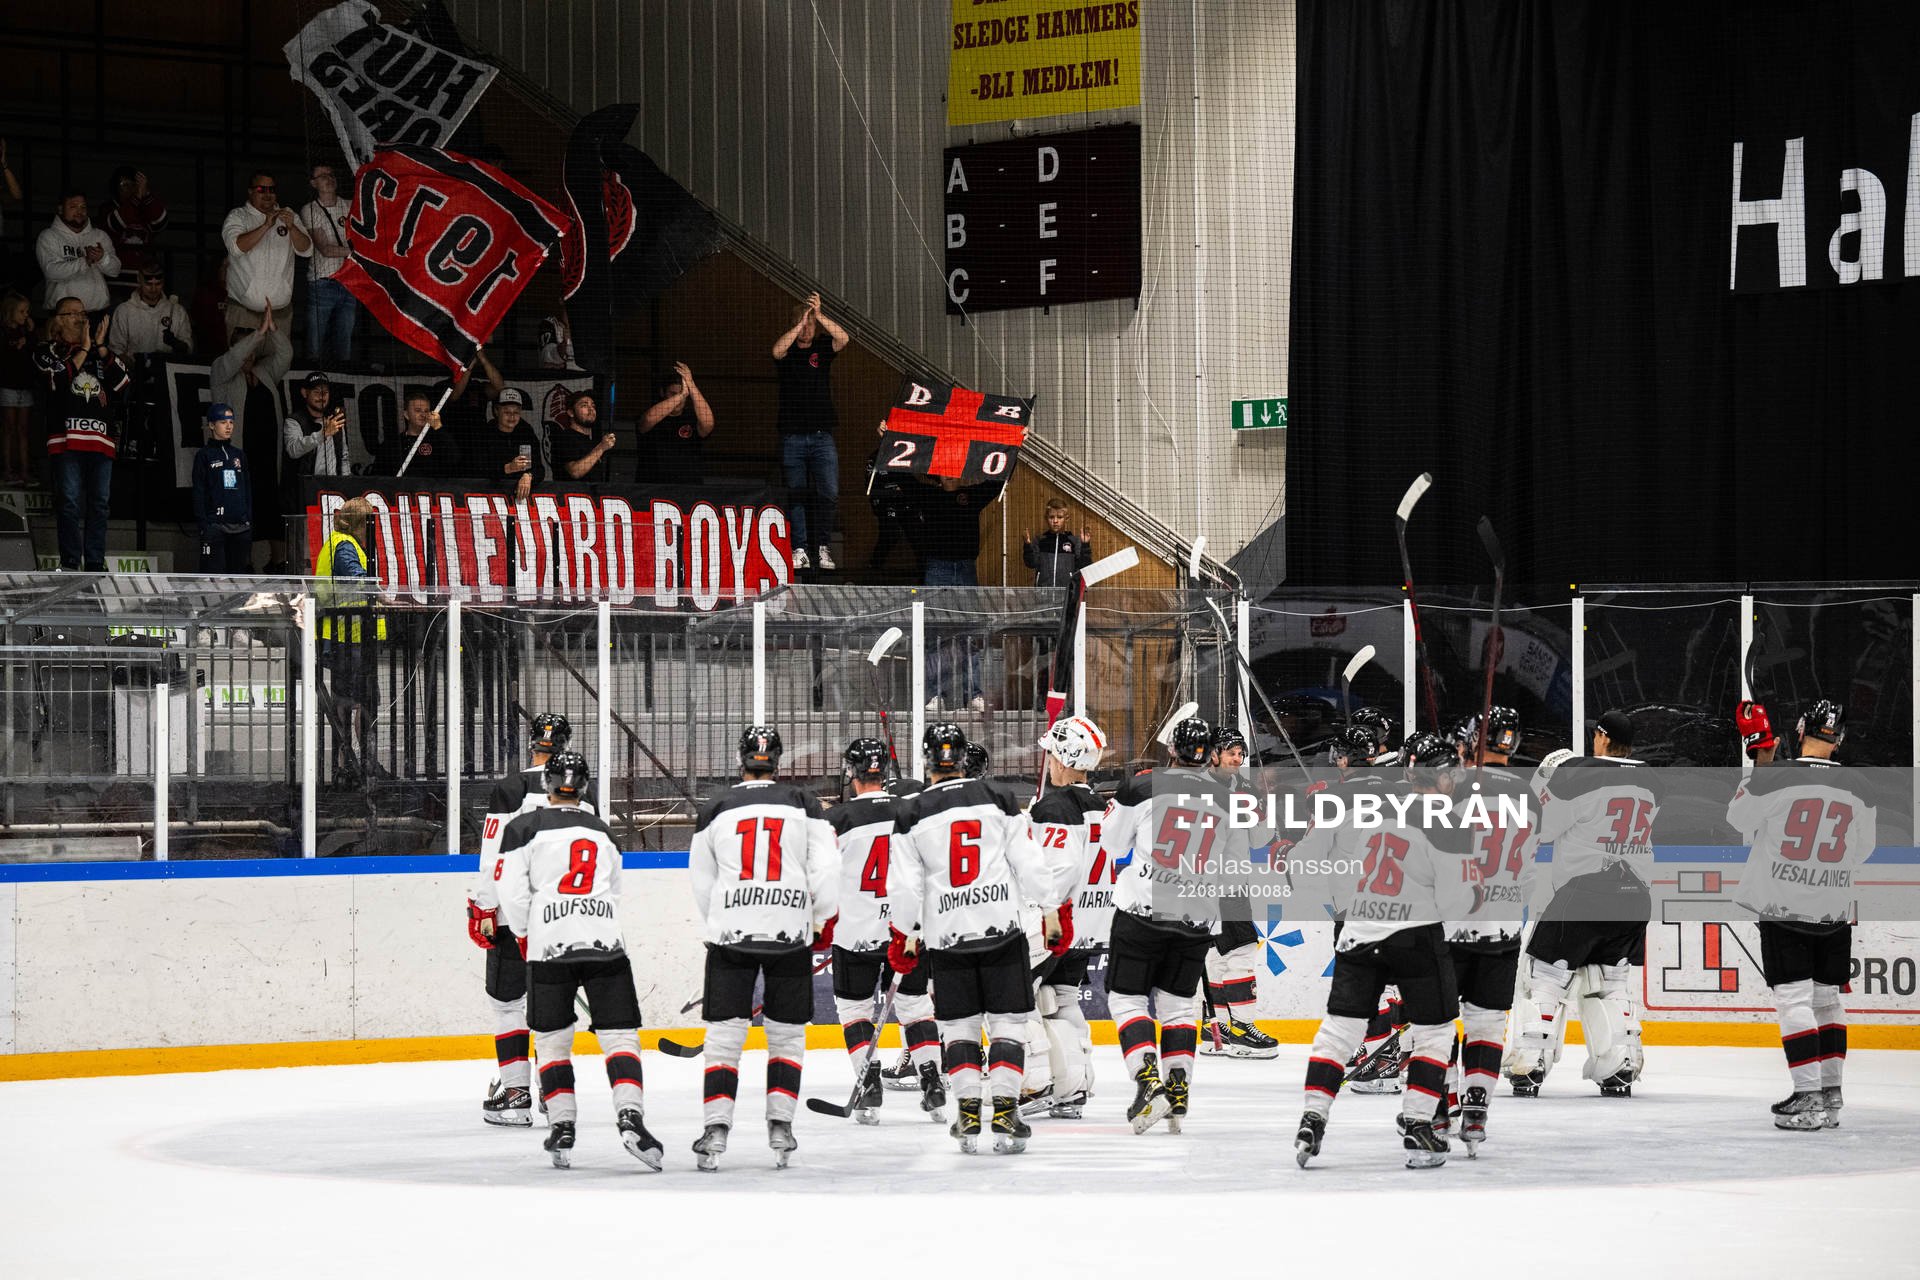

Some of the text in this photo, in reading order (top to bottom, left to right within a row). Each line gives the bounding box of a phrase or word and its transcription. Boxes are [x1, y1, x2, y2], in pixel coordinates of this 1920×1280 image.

[953, 1, 1138, 50] SLEDGE HAMMERS
[971, 58, 1119, 100] -BLI MEDLEM!
[946, 157, 969, 194] A
[1038, 146, 1060, 183] D
[946, 213, 967, 249] B
[1039, 202, 1058, 239] E
[948, 268, 970, 304] C
[1040, 258, 1057, 295] F
[887, 440, 1008, 475] 2 0
[118, 559, 150, 573] MTA
[653, 501, 789, 611] BOYS
[1042, 827, 1068, 849] 72
[1596, 796, 1655, 846] 35
[1780, 797, 1854, 864] 93
[557, 838, 599, 895] 8
[736, 816, 785, 882] 11
[949, 819, 982, 889] 6
[543, 897, 614, 924] OLOFSSON
[724, 886, 808, 910] LAURIDSEN
[938, 883, 1010, 914] JOHNSSON
[1351, 898, 1413, 921] LASSEN
